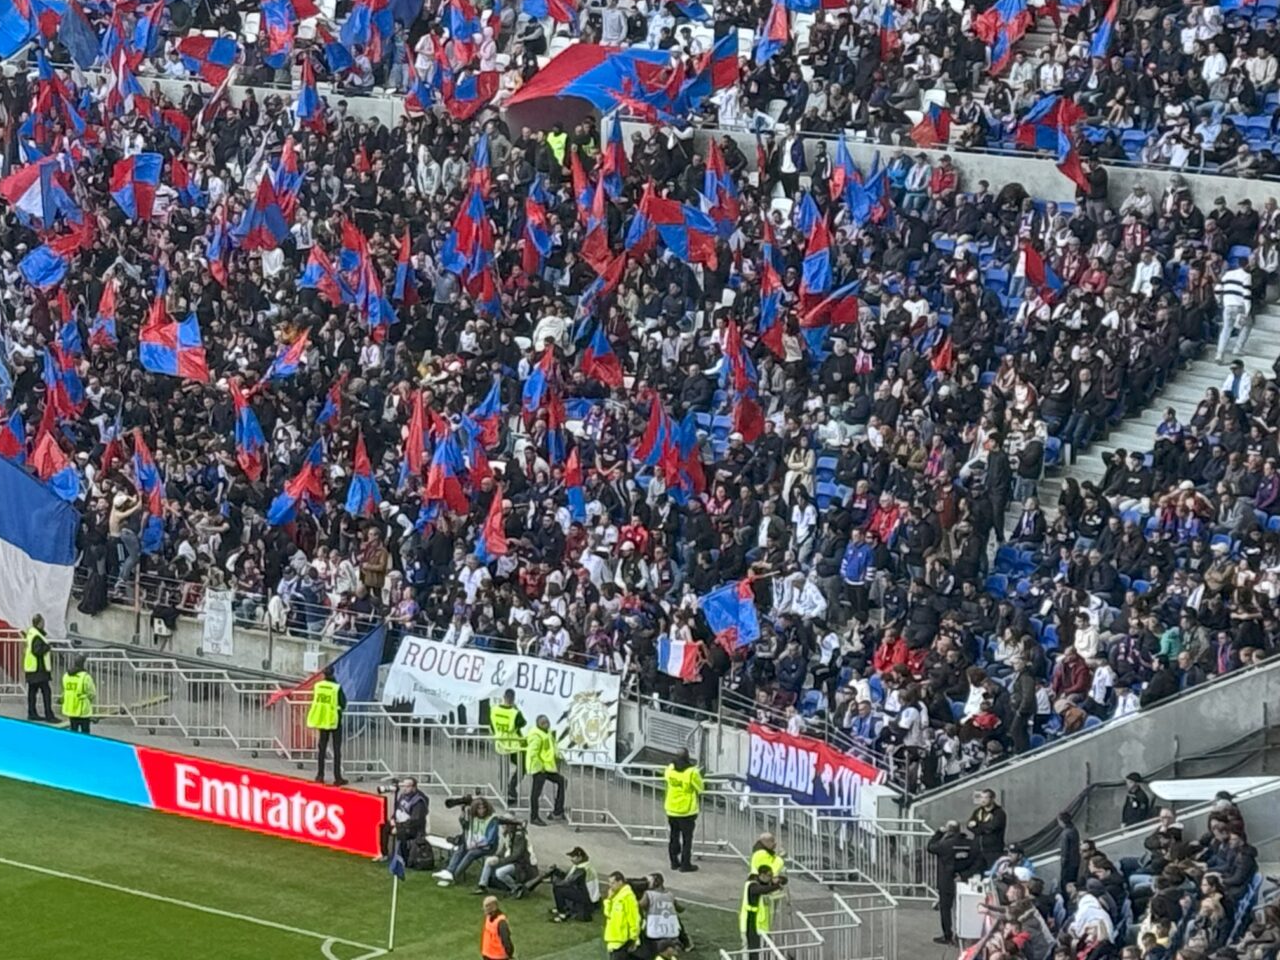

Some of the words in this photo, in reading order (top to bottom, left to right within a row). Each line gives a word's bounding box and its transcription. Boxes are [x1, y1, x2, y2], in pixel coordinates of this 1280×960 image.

[400, 642, 486, 683] ROUGE
[491, 659, 506, 687] &
[515, 661, 576, 699] BLEU
[174, 762, 346, 840] Emirates
